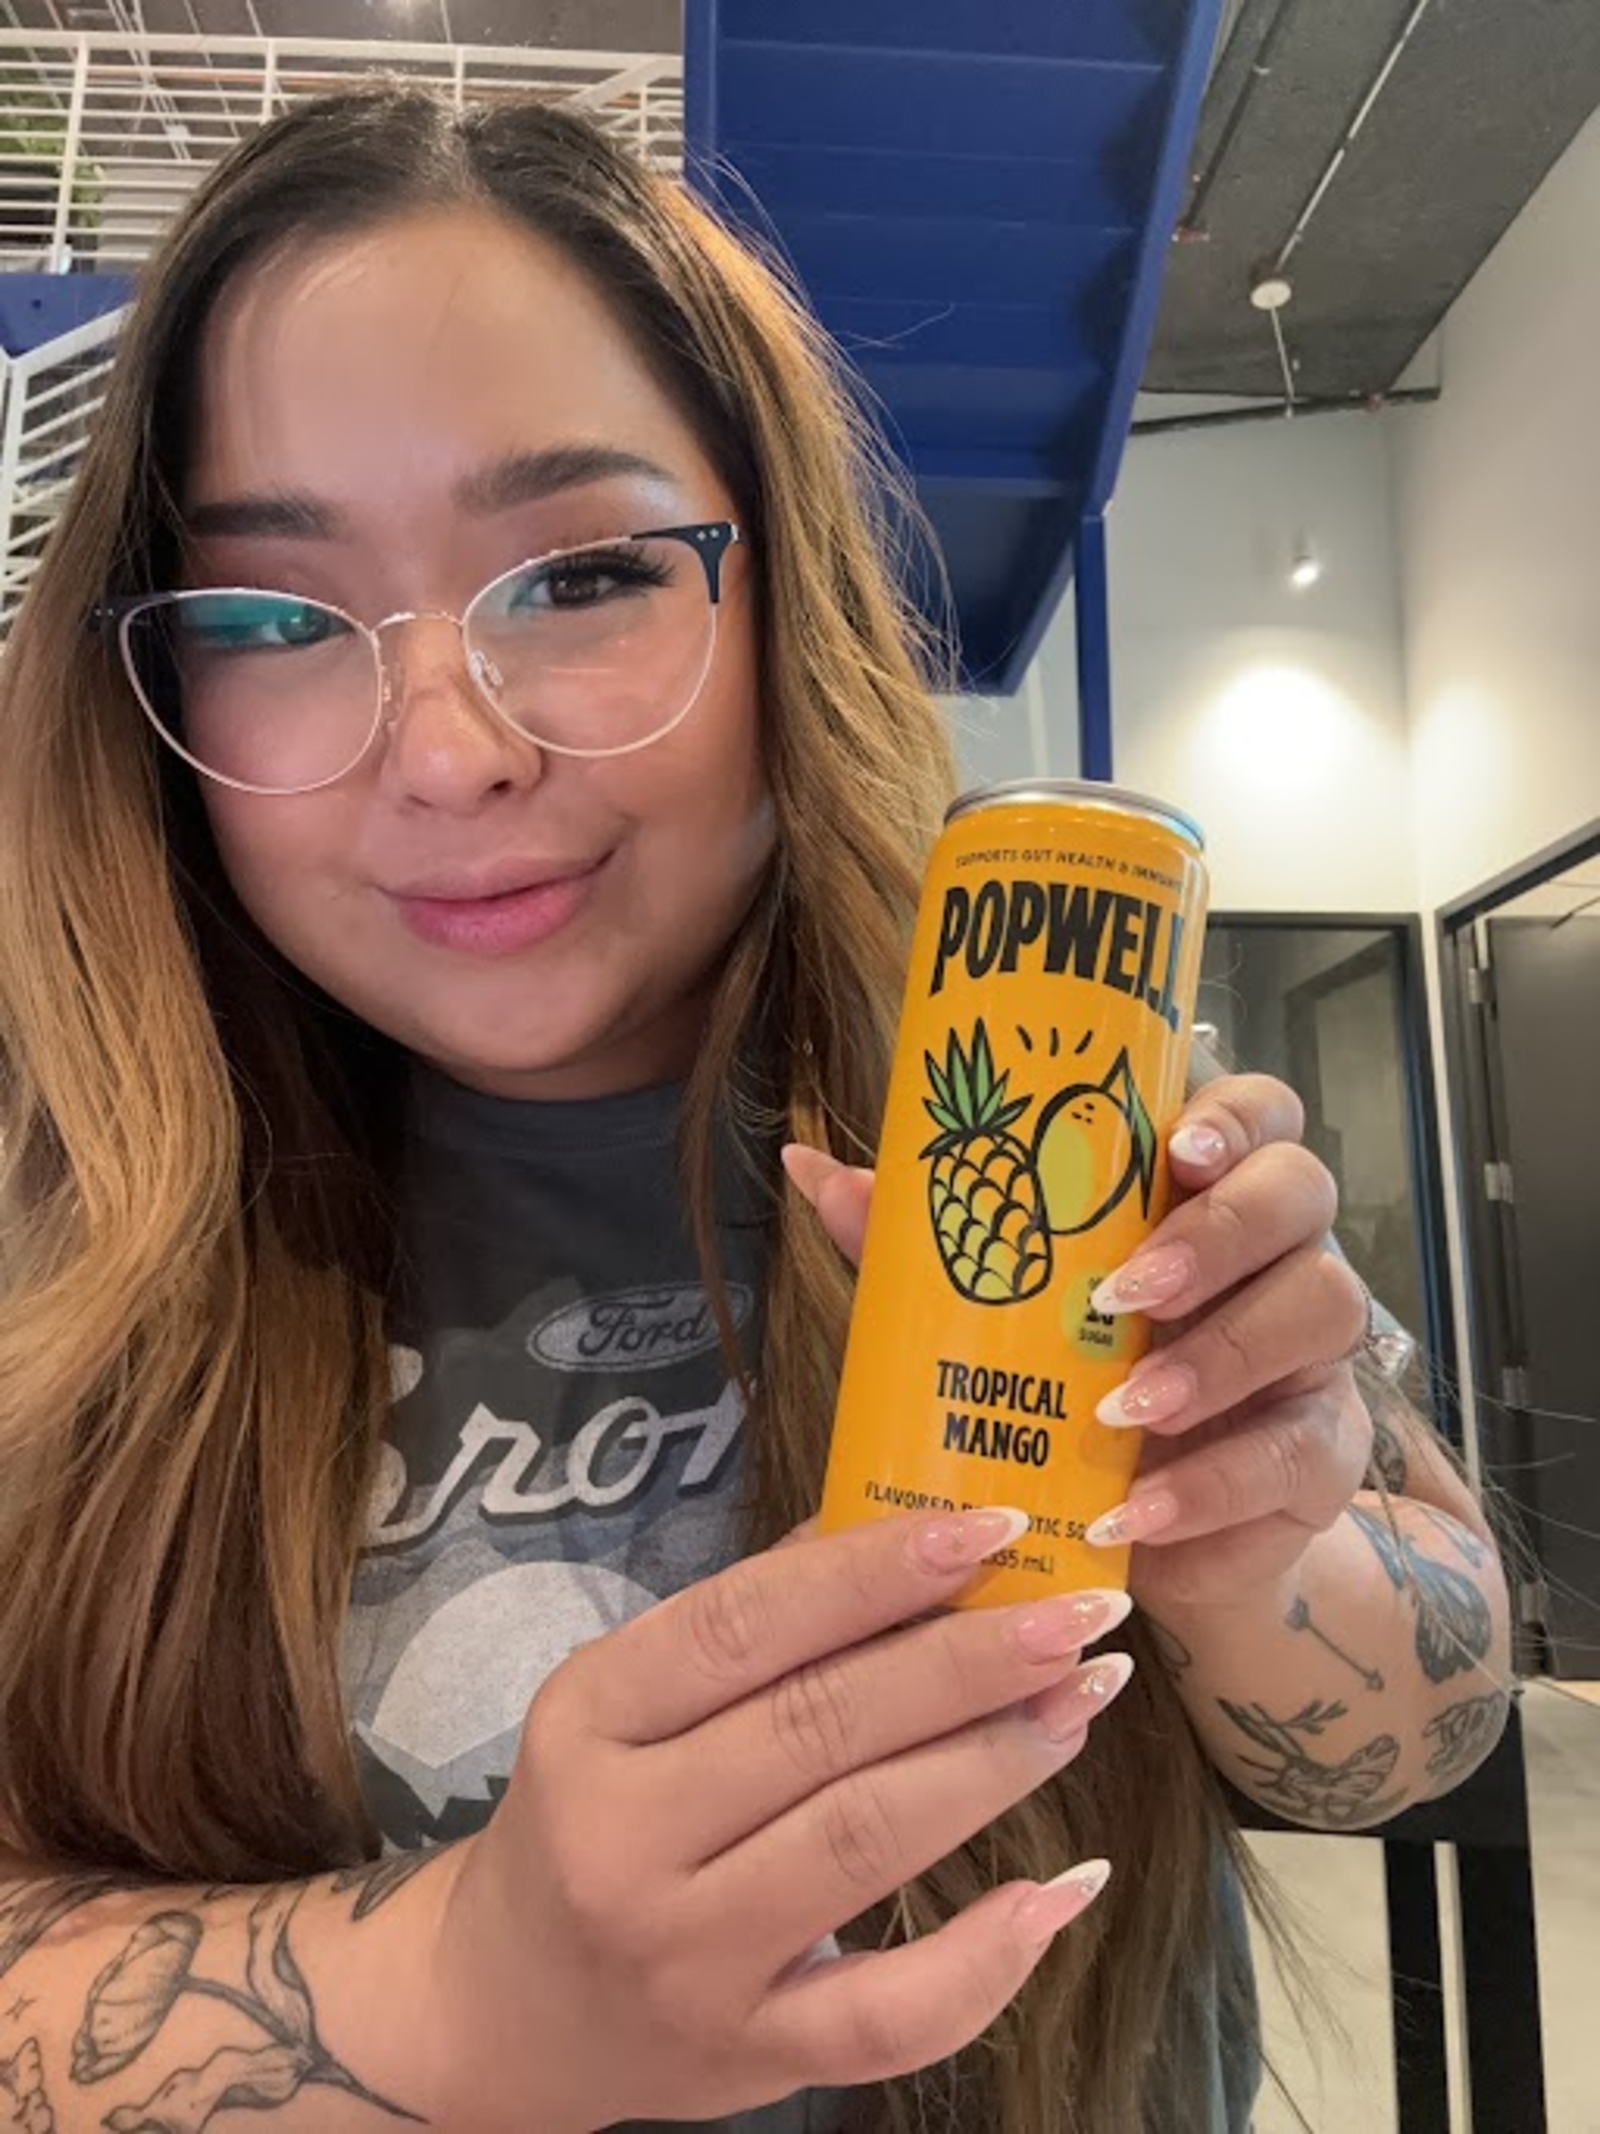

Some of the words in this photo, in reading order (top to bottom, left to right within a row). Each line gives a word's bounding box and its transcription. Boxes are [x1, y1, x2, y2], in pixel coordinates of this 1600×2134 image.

[1021, 850, 1053, 863] GUT
[1056, 851, 1115, 872] HEALTH
[928, 880, 1185, 1033] POPWELL
[578, 1296, 708, 1356] Ford
[937, 1359, 1067, 1420] TROPICAL
[943, 1412, 1049, 1467] MANGO
[864, 1480, 955, 1512] FLAVORED
